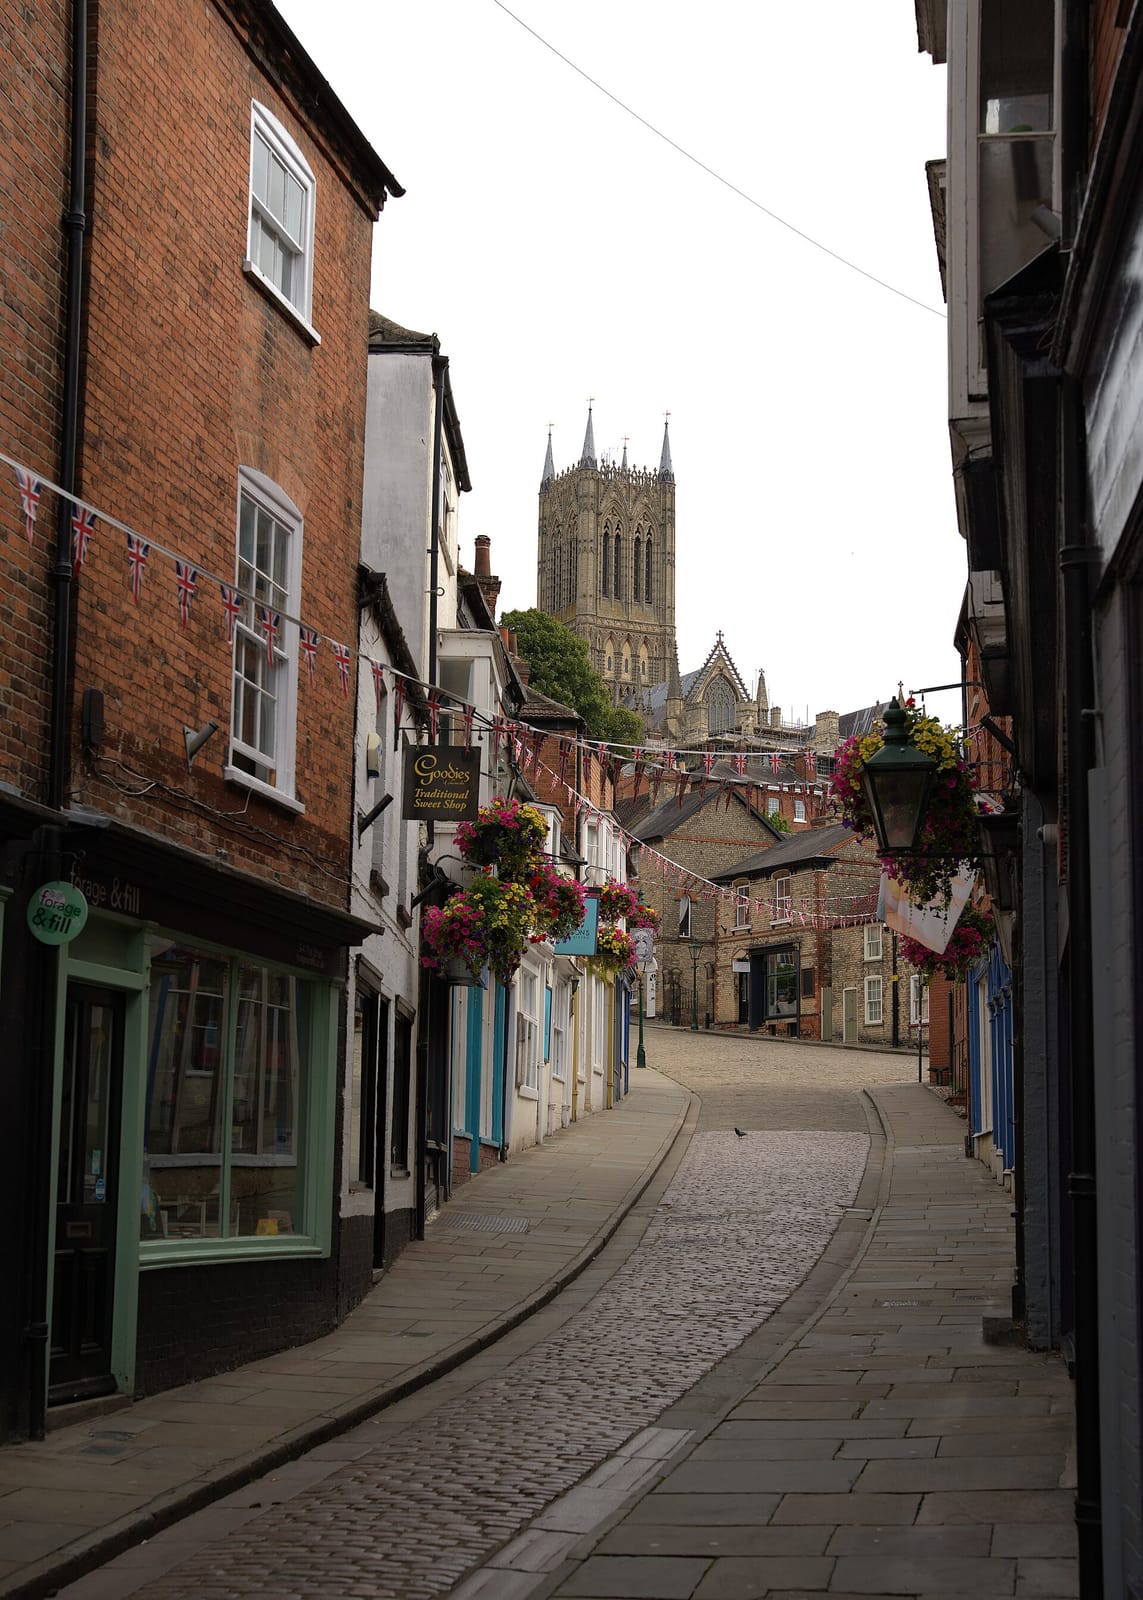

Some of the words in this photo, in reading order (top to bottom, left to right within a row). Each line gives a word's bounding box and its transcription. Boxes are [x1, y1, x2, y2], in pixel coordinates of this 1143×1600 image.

[413, 754, 470, 786] Goodies
[414, 788, 470, 799] Traditional
[413, 798, 442, 809] Sweet
[443, 799, 468, 812] Shop
[40, 889, 82, 917] forage
